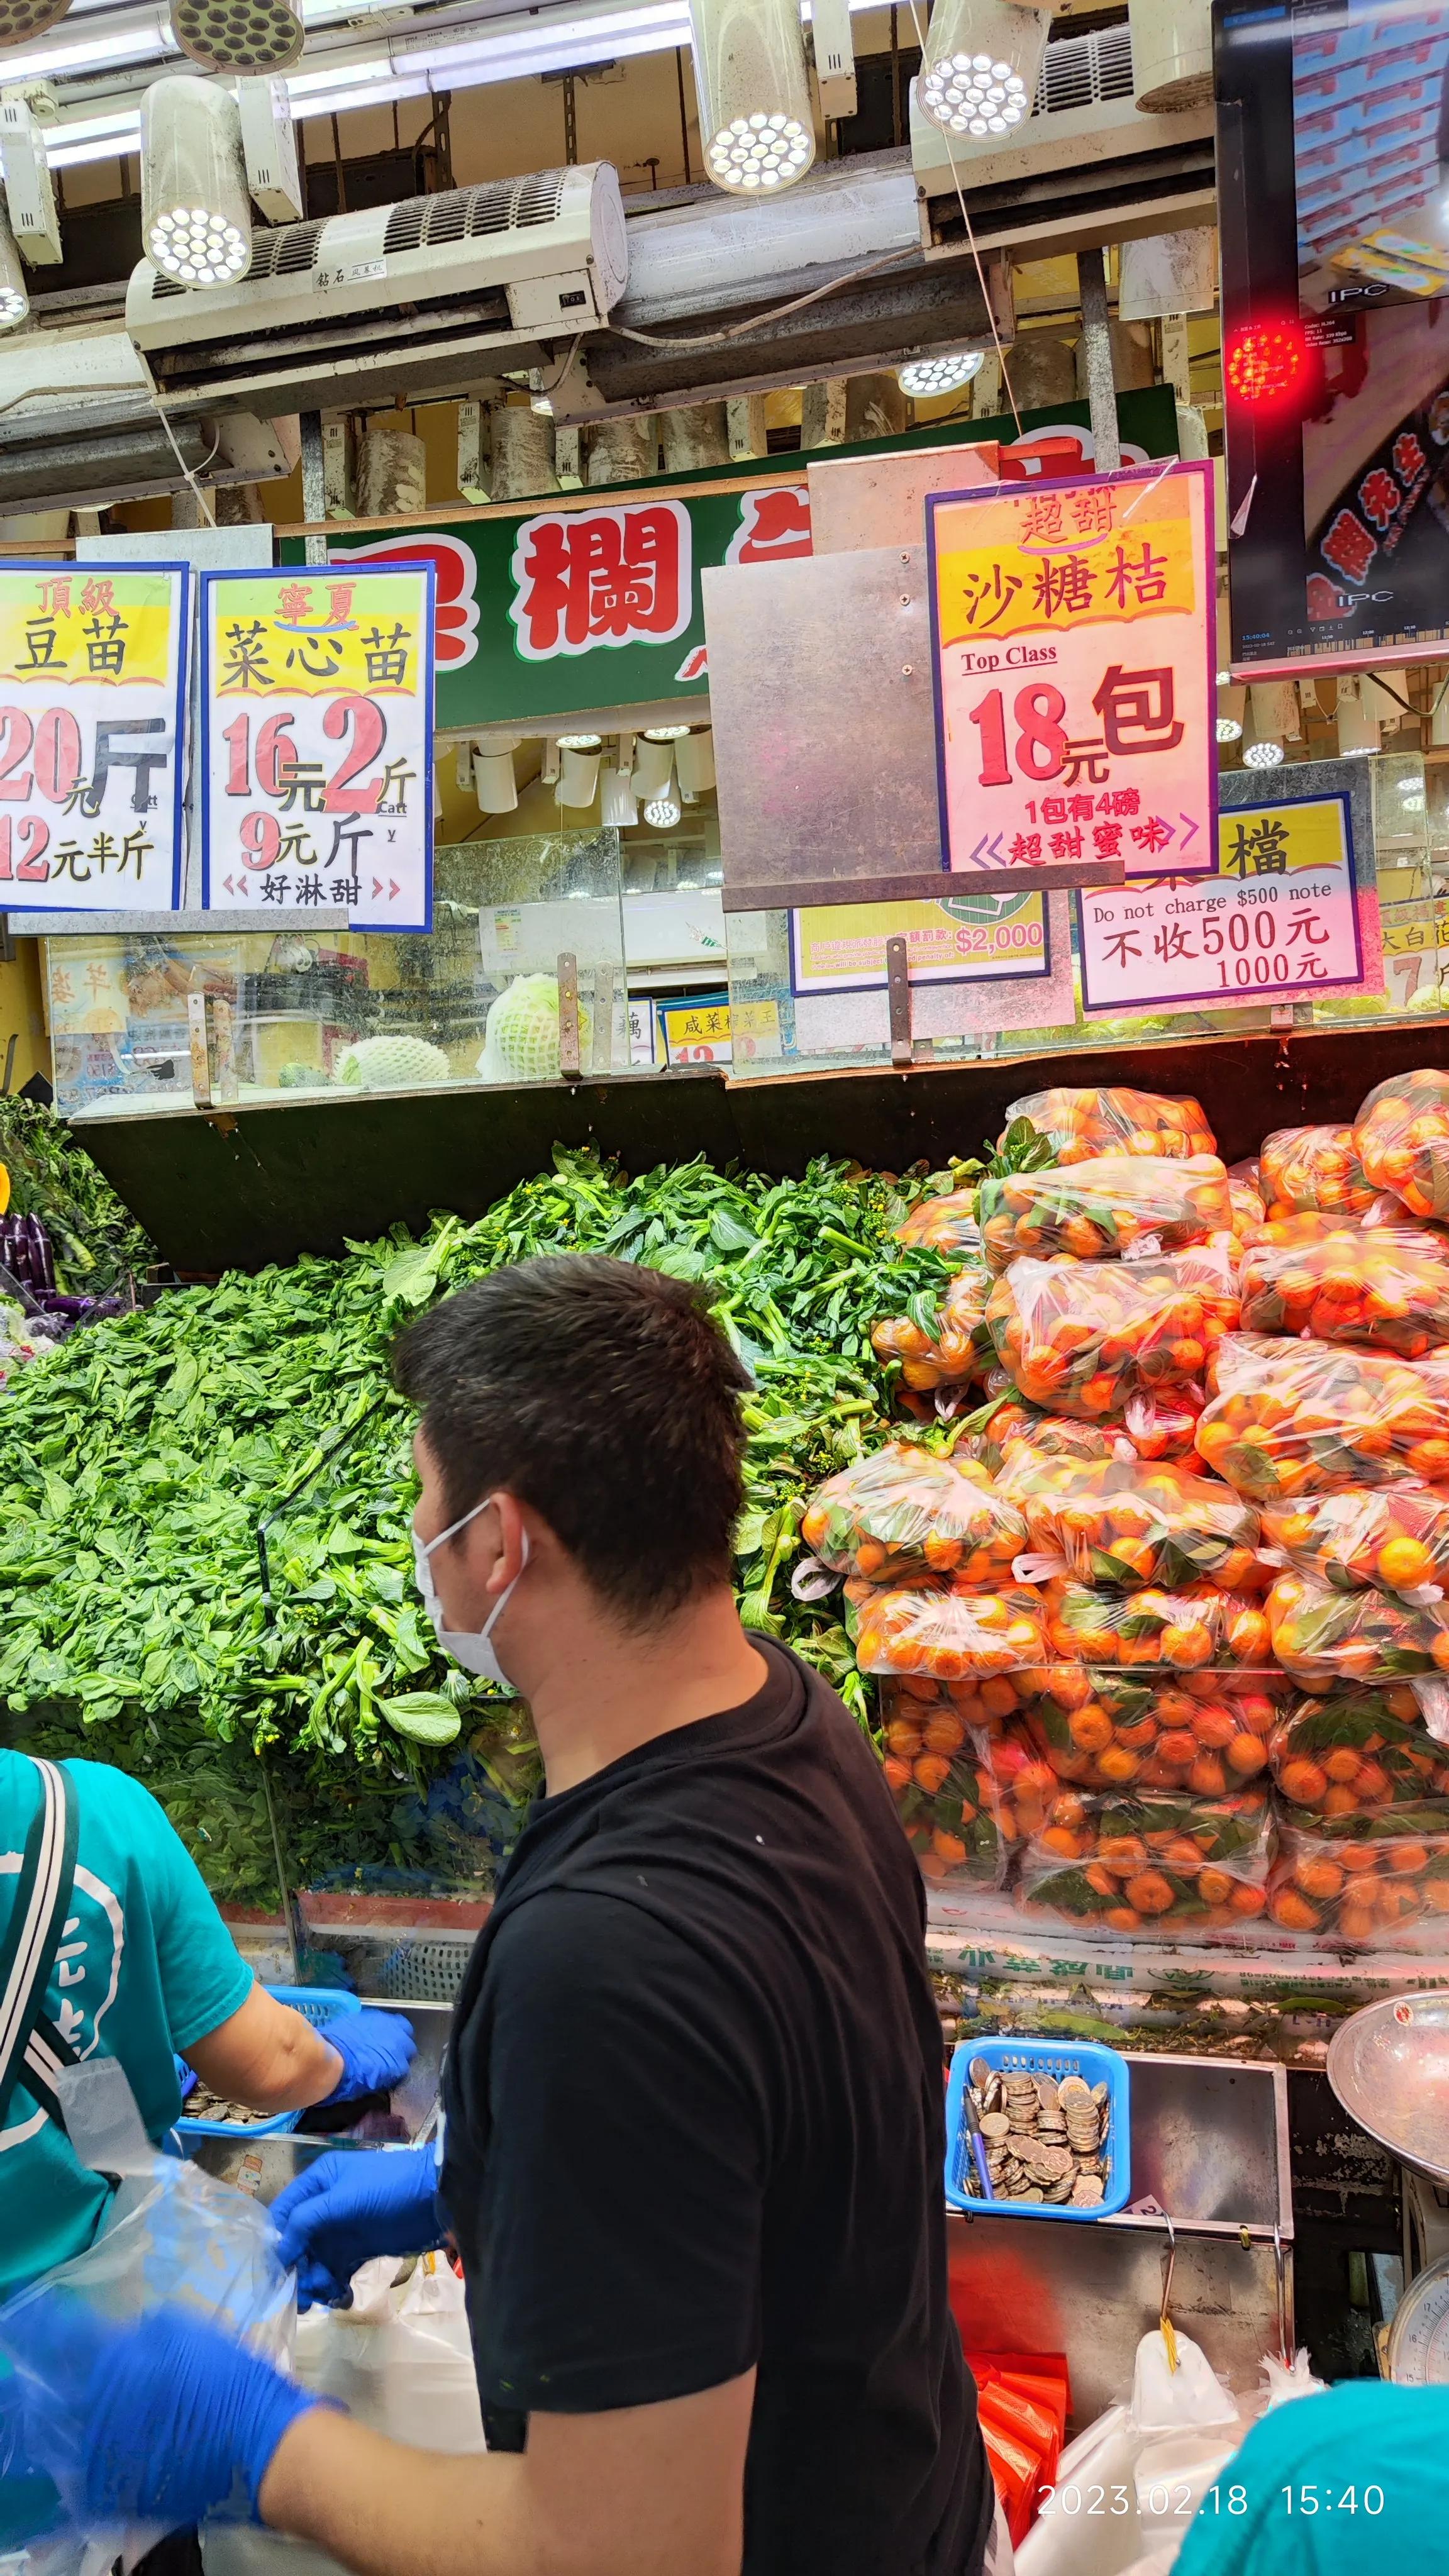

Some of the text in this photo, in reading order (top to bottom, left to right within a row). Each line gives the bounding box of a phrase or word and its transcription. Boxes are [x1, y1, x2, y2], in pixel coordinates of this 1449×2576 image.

[315, 269, 345, 287] 钻石
[1331, 284, 1387, 302] IPC
[36, 577, 121, 618] 頂級
[962, 542, 1169, 629] 沙糖桔
[1339, 591, 1394, 607] IPC
[274, 582, 360, 631] 寧夏
[14, 617, 130, 675] 豆苗
[221, 620, 413, 687] 菜心苗
[1242, 633, 1270, 641] 15:40:04
[961, 646, 1057, 672] Top Class
[1024, 788, 1141, 825] 1包有4磅
[1008, 816, 1170, 866] 超甜蜜味
[260, 873, 362, 907] 好淋甜
[1094, 884, 1332, 923] Do not charge $500 note
[955, 923, 1043, 956] $2,000
[1102, 908, 1330, 969] 不收500元
[918, 953, 943, 962] penalty
[1217, 952, 1328, 988] 1000元
[1423, 2302, 1431, 2312] 17
[1409, 2333, 1417, 2343] 16
[1406, 2373, 1414, 2382] 15
